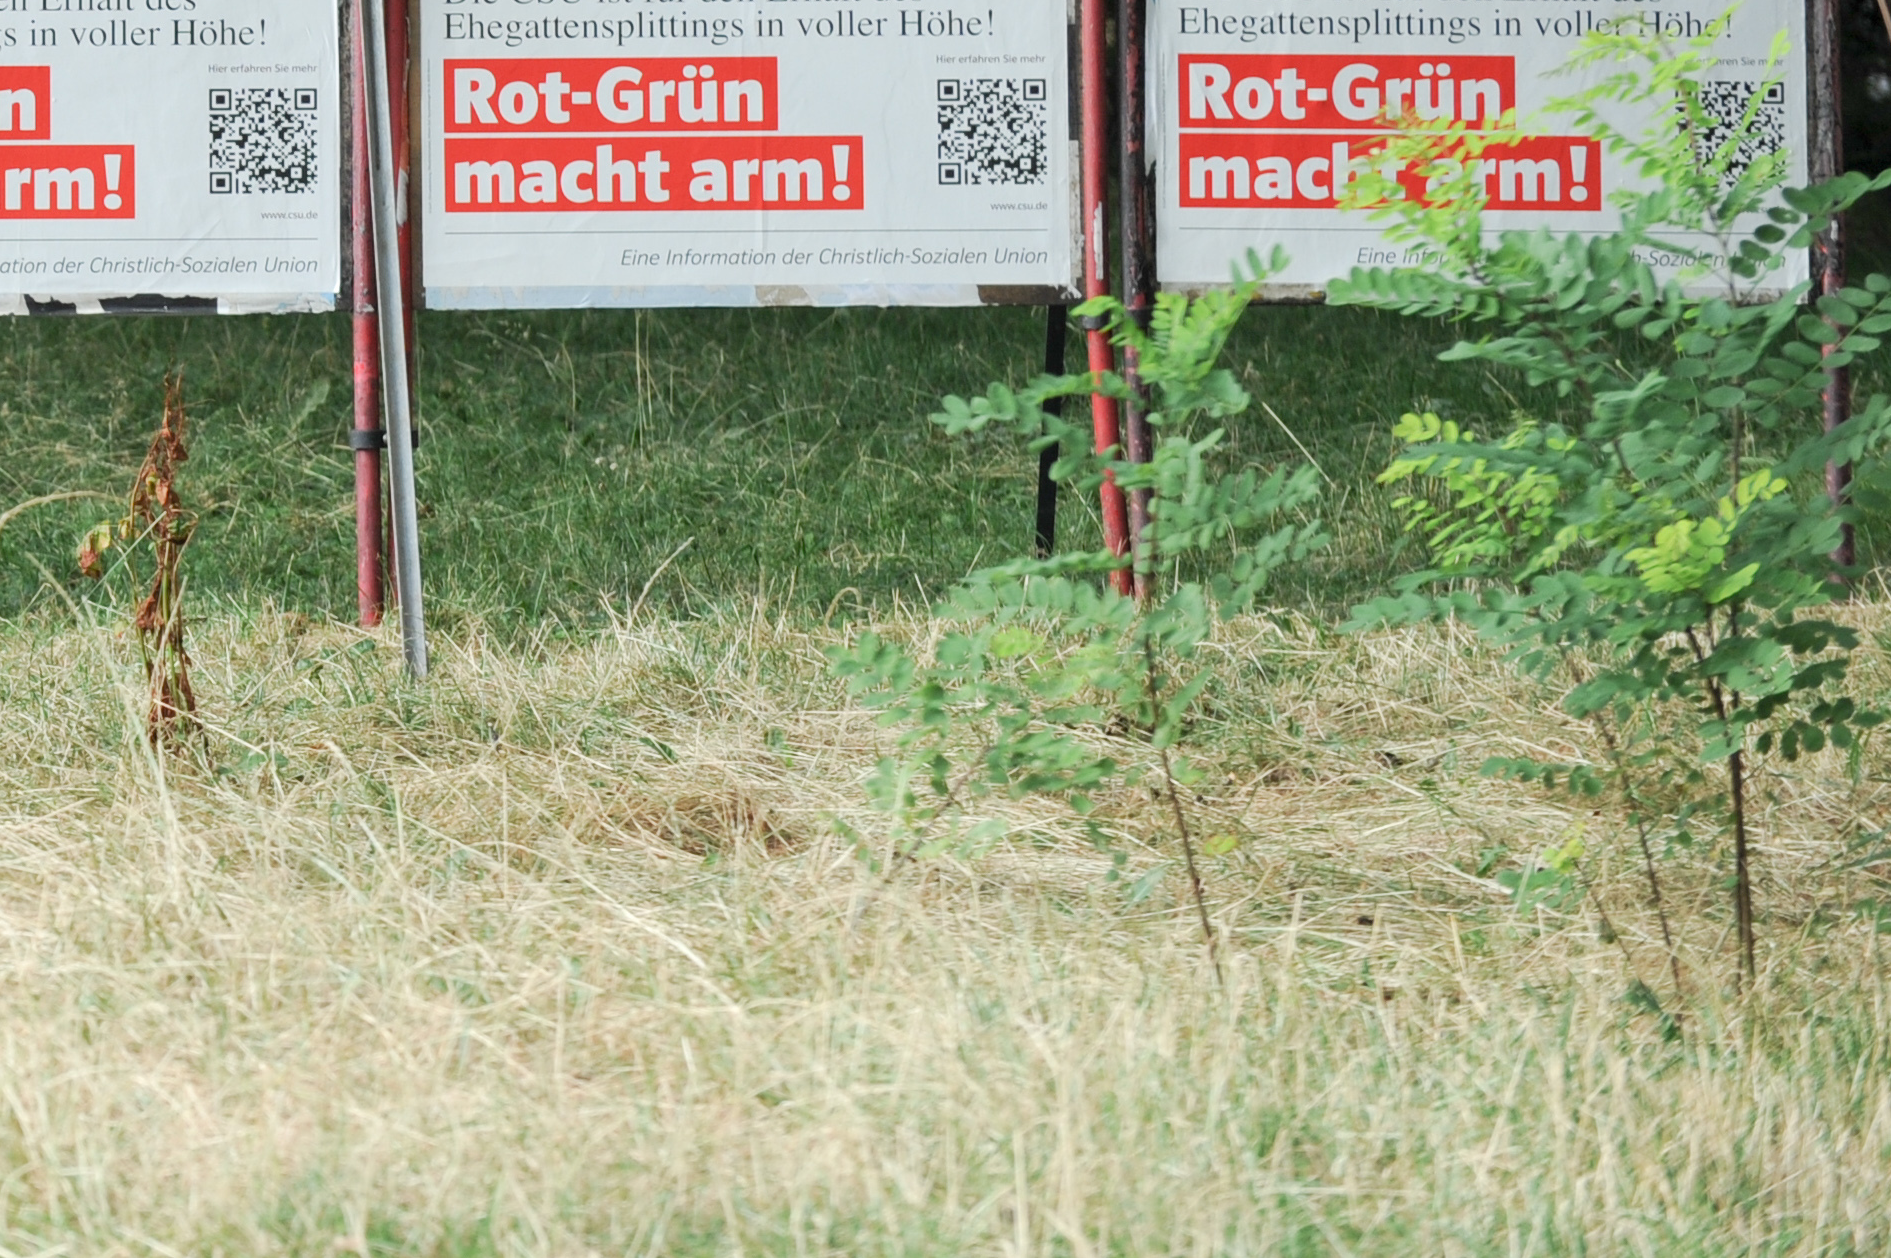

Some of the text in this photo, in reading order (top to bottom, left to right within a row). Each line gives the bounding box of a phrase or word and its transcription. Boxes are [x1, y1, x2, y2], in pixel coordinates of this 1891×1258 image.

[31, 20, 56, 46] in
[70, 19, 160, 46] voller
[172, 19, 265, 46] Höhe!
[935, 54, 1046, 64] Hier erfahren Sie mehr
[208, 64, 317, 73] Hier erfahren Sie mehr
[454, 64, 764, 125] Rot-Grün
[1189, 63, 1500, 122] Rot-Grün
[454, 144, 851, 204] macht arm!
[990, 200, 1048, 210] www.csu.de
[261, 210, 318, 219] www.csu.de
[621, 247, 1049, 266] Eine Information der Christlich-Sozialen Union
[1356, 247, 1396, 264] Eine
[53, 257, 84, 273] der
[90, 256, 257, 273] Christlich-Sozialen
[265, 257, 318, 273] Union
